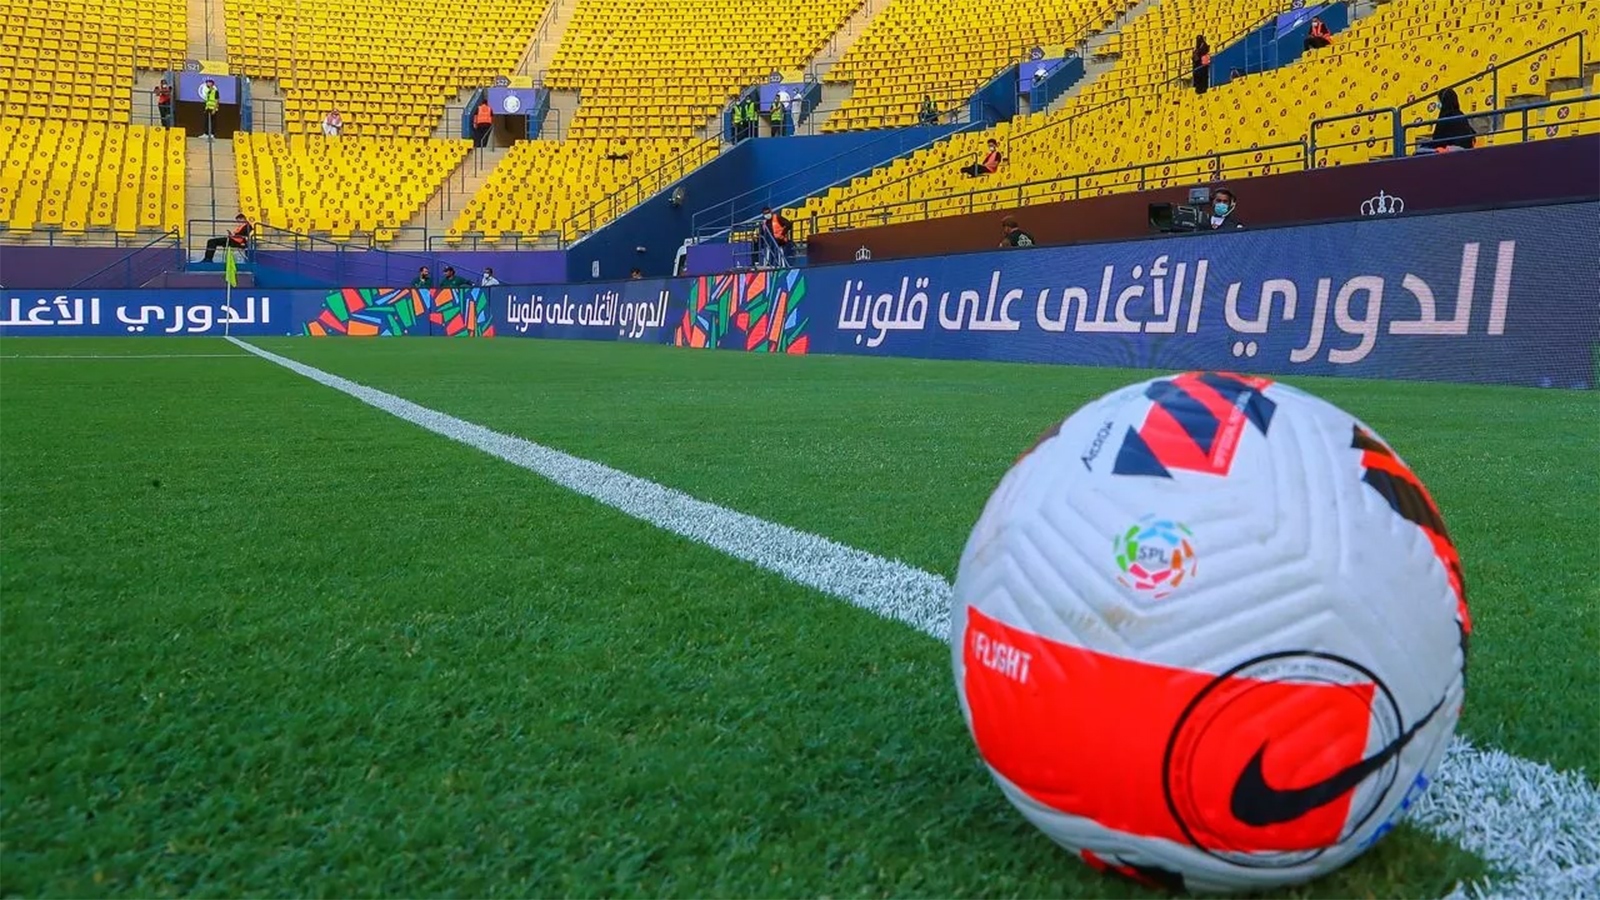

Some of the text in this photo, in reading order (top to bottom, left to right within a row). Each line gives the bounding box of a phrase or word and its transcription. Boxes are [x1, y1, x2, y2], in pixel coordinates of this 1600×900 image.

[187, 63, 200, 71] S21
[0, 296, 270, 333] الدوري الأغل
[507, 290, 669, 338] الدوري الأغلى على قلوبنا
[837, 239, 1516, 364] الدوري الأغلى على قلوبنا
[1138, 545, 1169, 565] SPL
[974, 630, 1034, 684] FLIGHT
